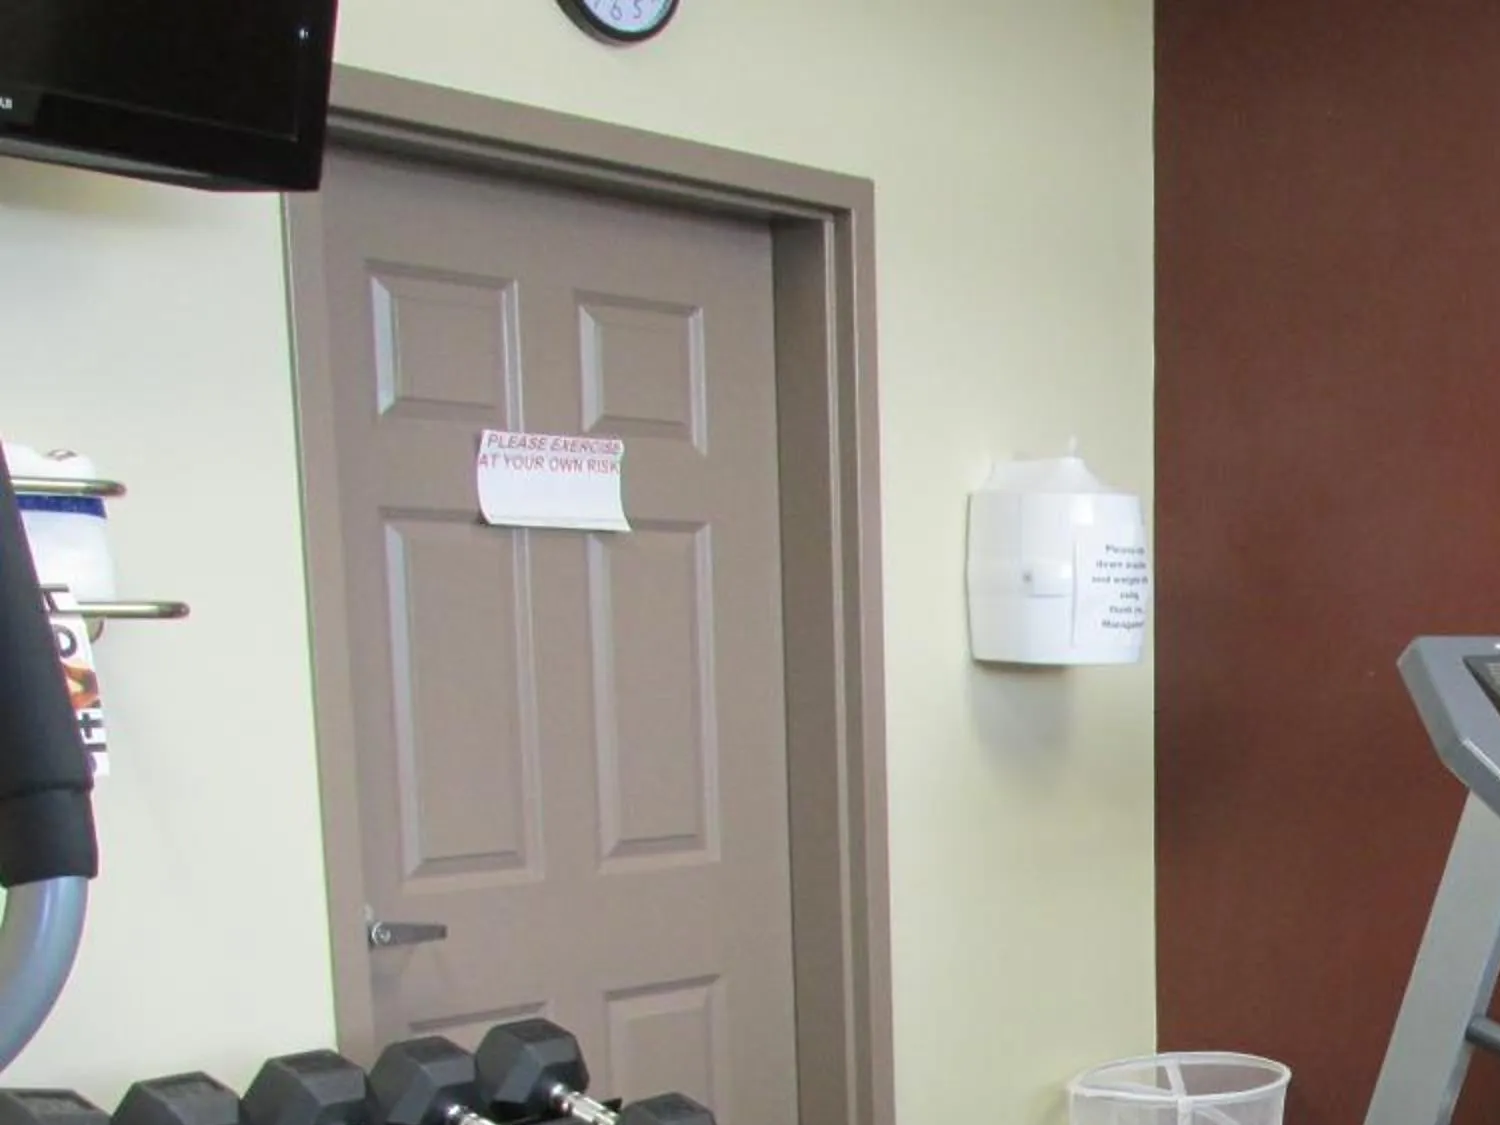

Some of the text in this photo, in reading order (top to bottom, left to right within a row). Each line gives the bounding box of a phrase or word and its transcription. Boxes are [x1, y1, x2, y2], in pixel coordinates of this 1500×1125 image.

[487, 434, 547, 449] PLEASE
[479, 453, 620, 474] AT YOUR OWN RISK
